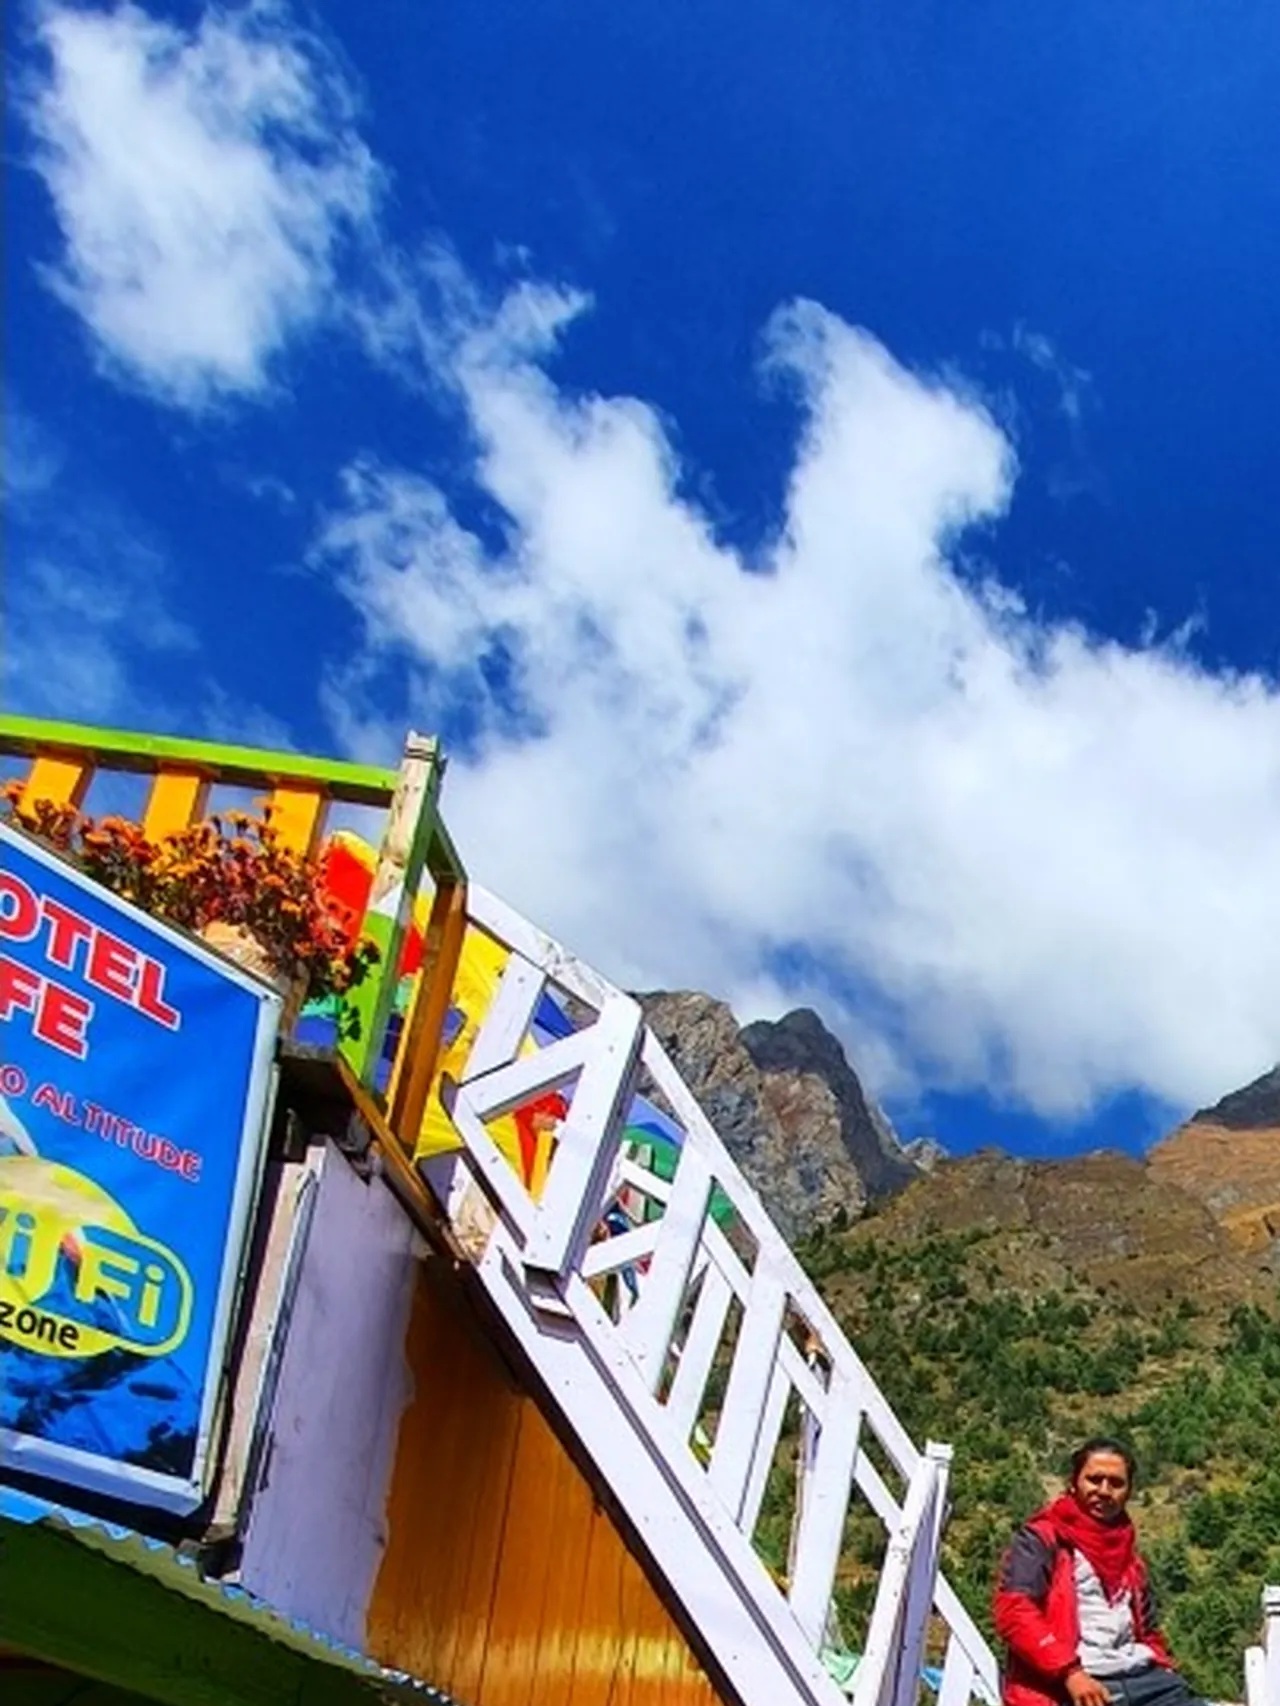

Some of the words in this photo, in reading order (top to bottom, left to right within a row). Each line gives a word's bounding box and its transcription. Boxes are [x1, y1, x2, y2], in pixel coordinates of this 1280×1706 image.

[0, 868, 182, 1031] OTEL
[31, 1082, 203, 1183] ALTITUDE
[0, 1302, 80, 1350] zone
